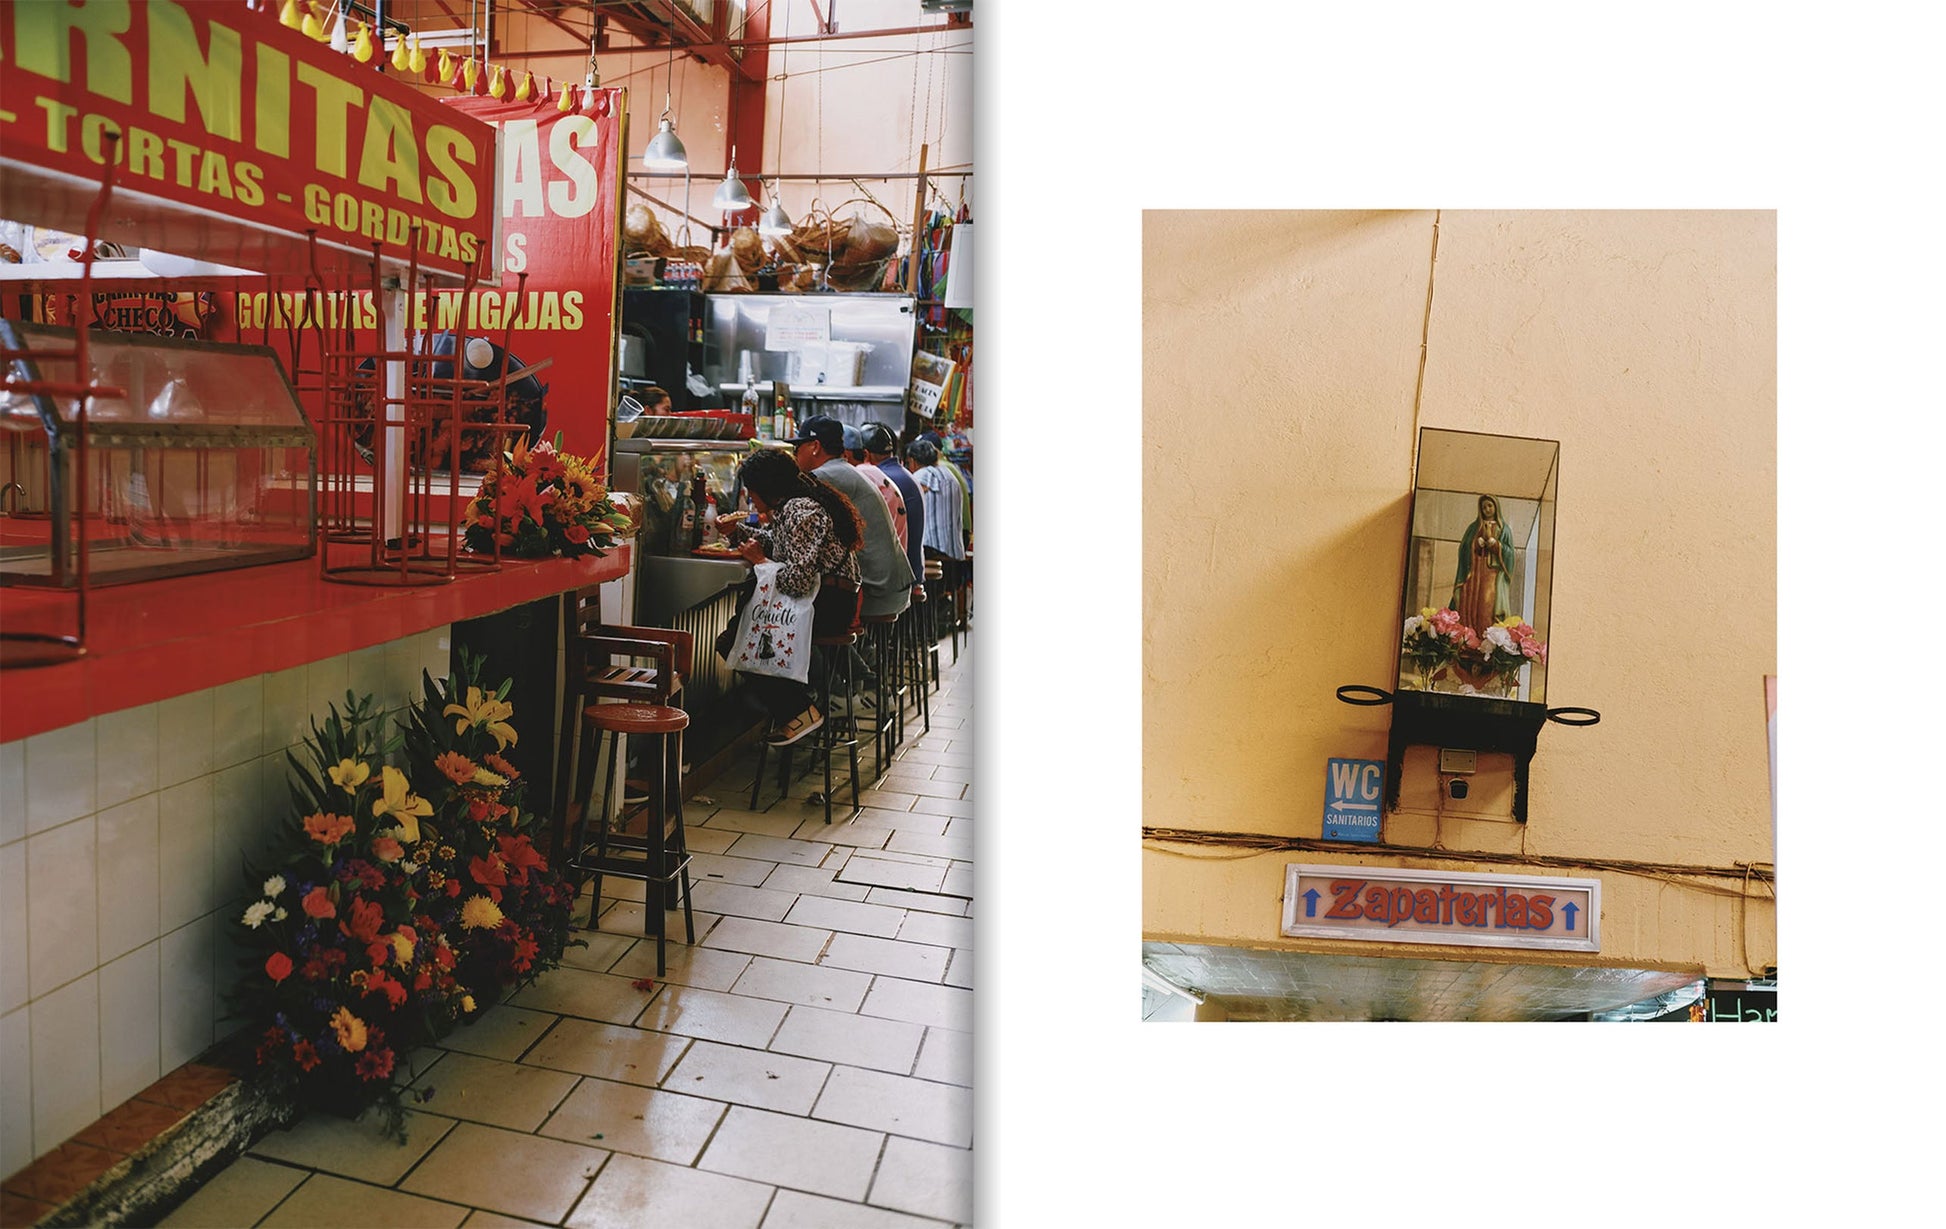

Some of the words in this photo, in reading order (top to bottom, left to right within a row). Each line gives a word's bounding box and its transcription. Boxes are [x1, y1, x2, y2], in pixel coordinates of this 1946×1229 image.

[0, 0, 478, 220] RNITAS
[35, 96, 265, 206] TORTAS
[304, 183, 478, 264] GORDITAS
[484, 114, 599, 219] AS
[501, 232, 527, 273] S
[235, 292, 378, 330] GORDITAS
[438, 290, 583, 331] MIGAJAS
[1332, 763, 1380, 800] WC
[1326, 814, 1378, 827] SANITARIOS
[1324, 878, 1557, 931] Zapaterias
